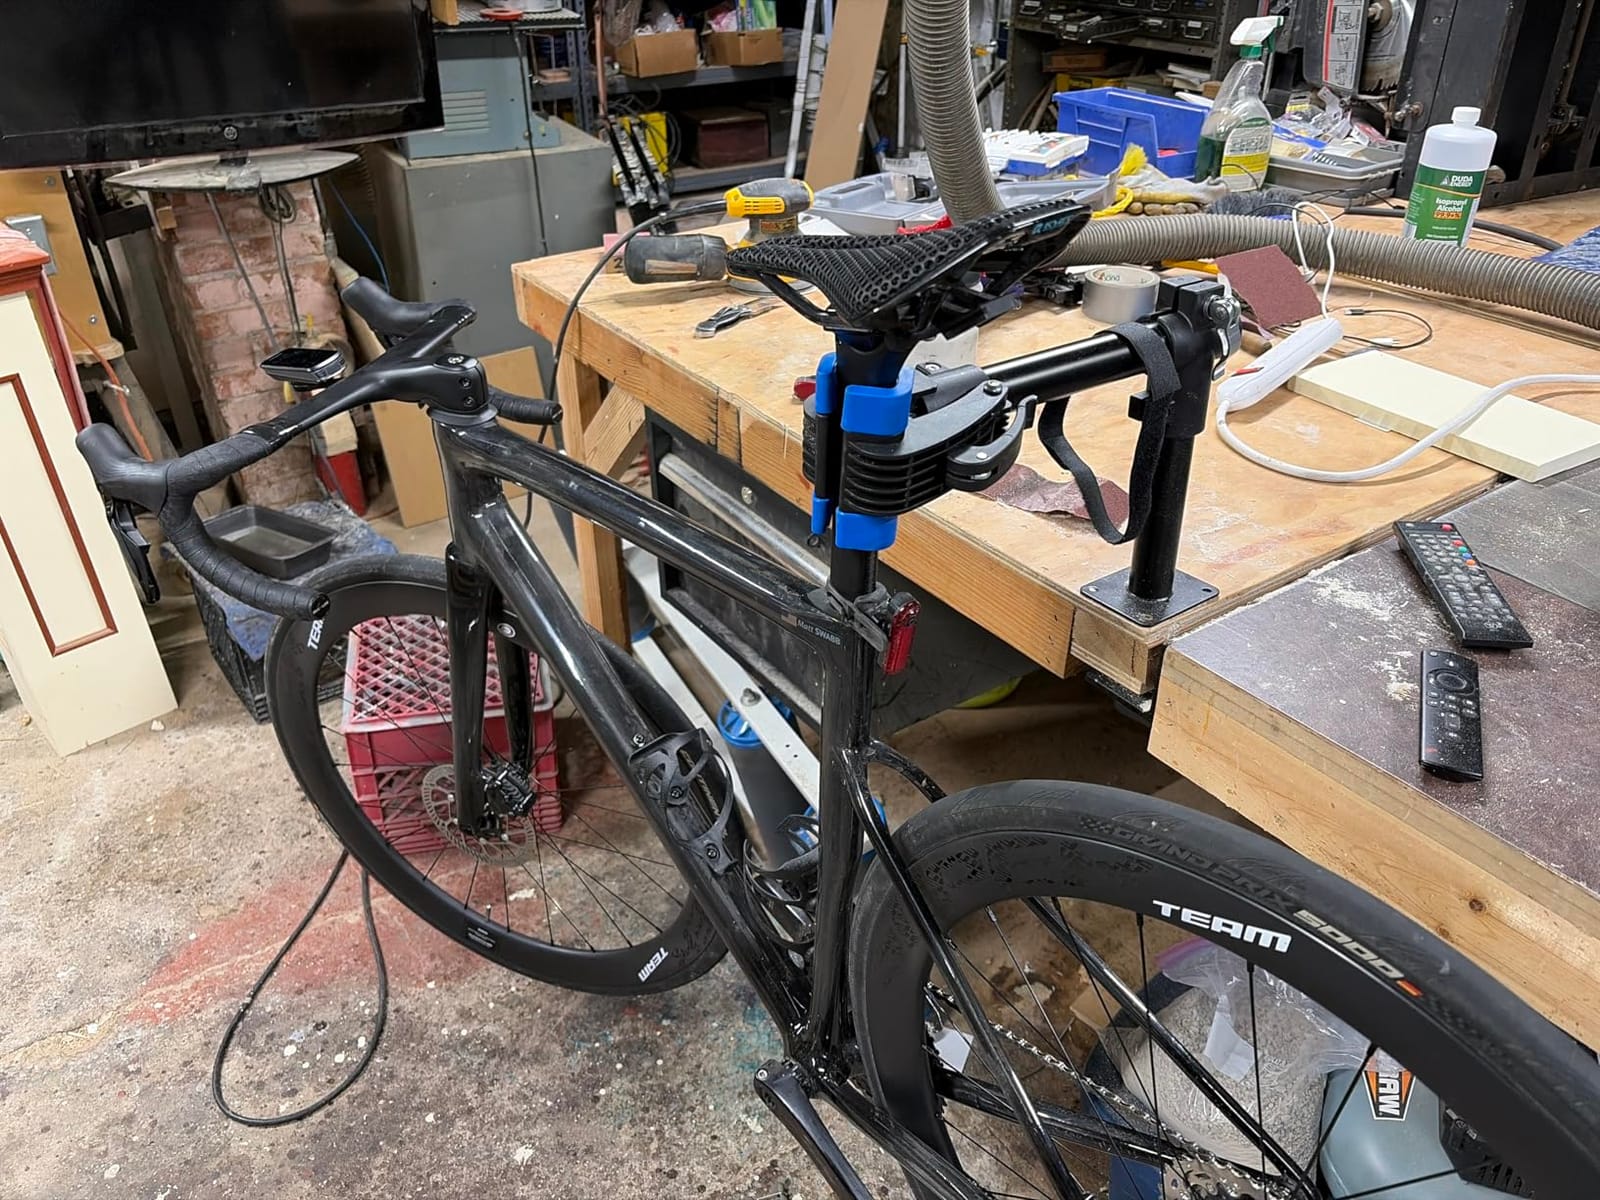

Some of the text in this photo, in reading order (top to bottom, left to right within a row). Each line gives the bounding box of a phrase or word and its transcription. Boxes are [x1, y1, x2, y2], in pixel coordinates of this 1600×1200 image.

[1435, 197, 1469, 207] Isopropyl
[1436, 204, 1464, 213] Alcohol
[307, 618, 325, 650] TEA
[1152, 899, 1293, 953] TEAM
[1293, 909, 1405, 979] 5000
[638, 947, 669, 983] TEAM
